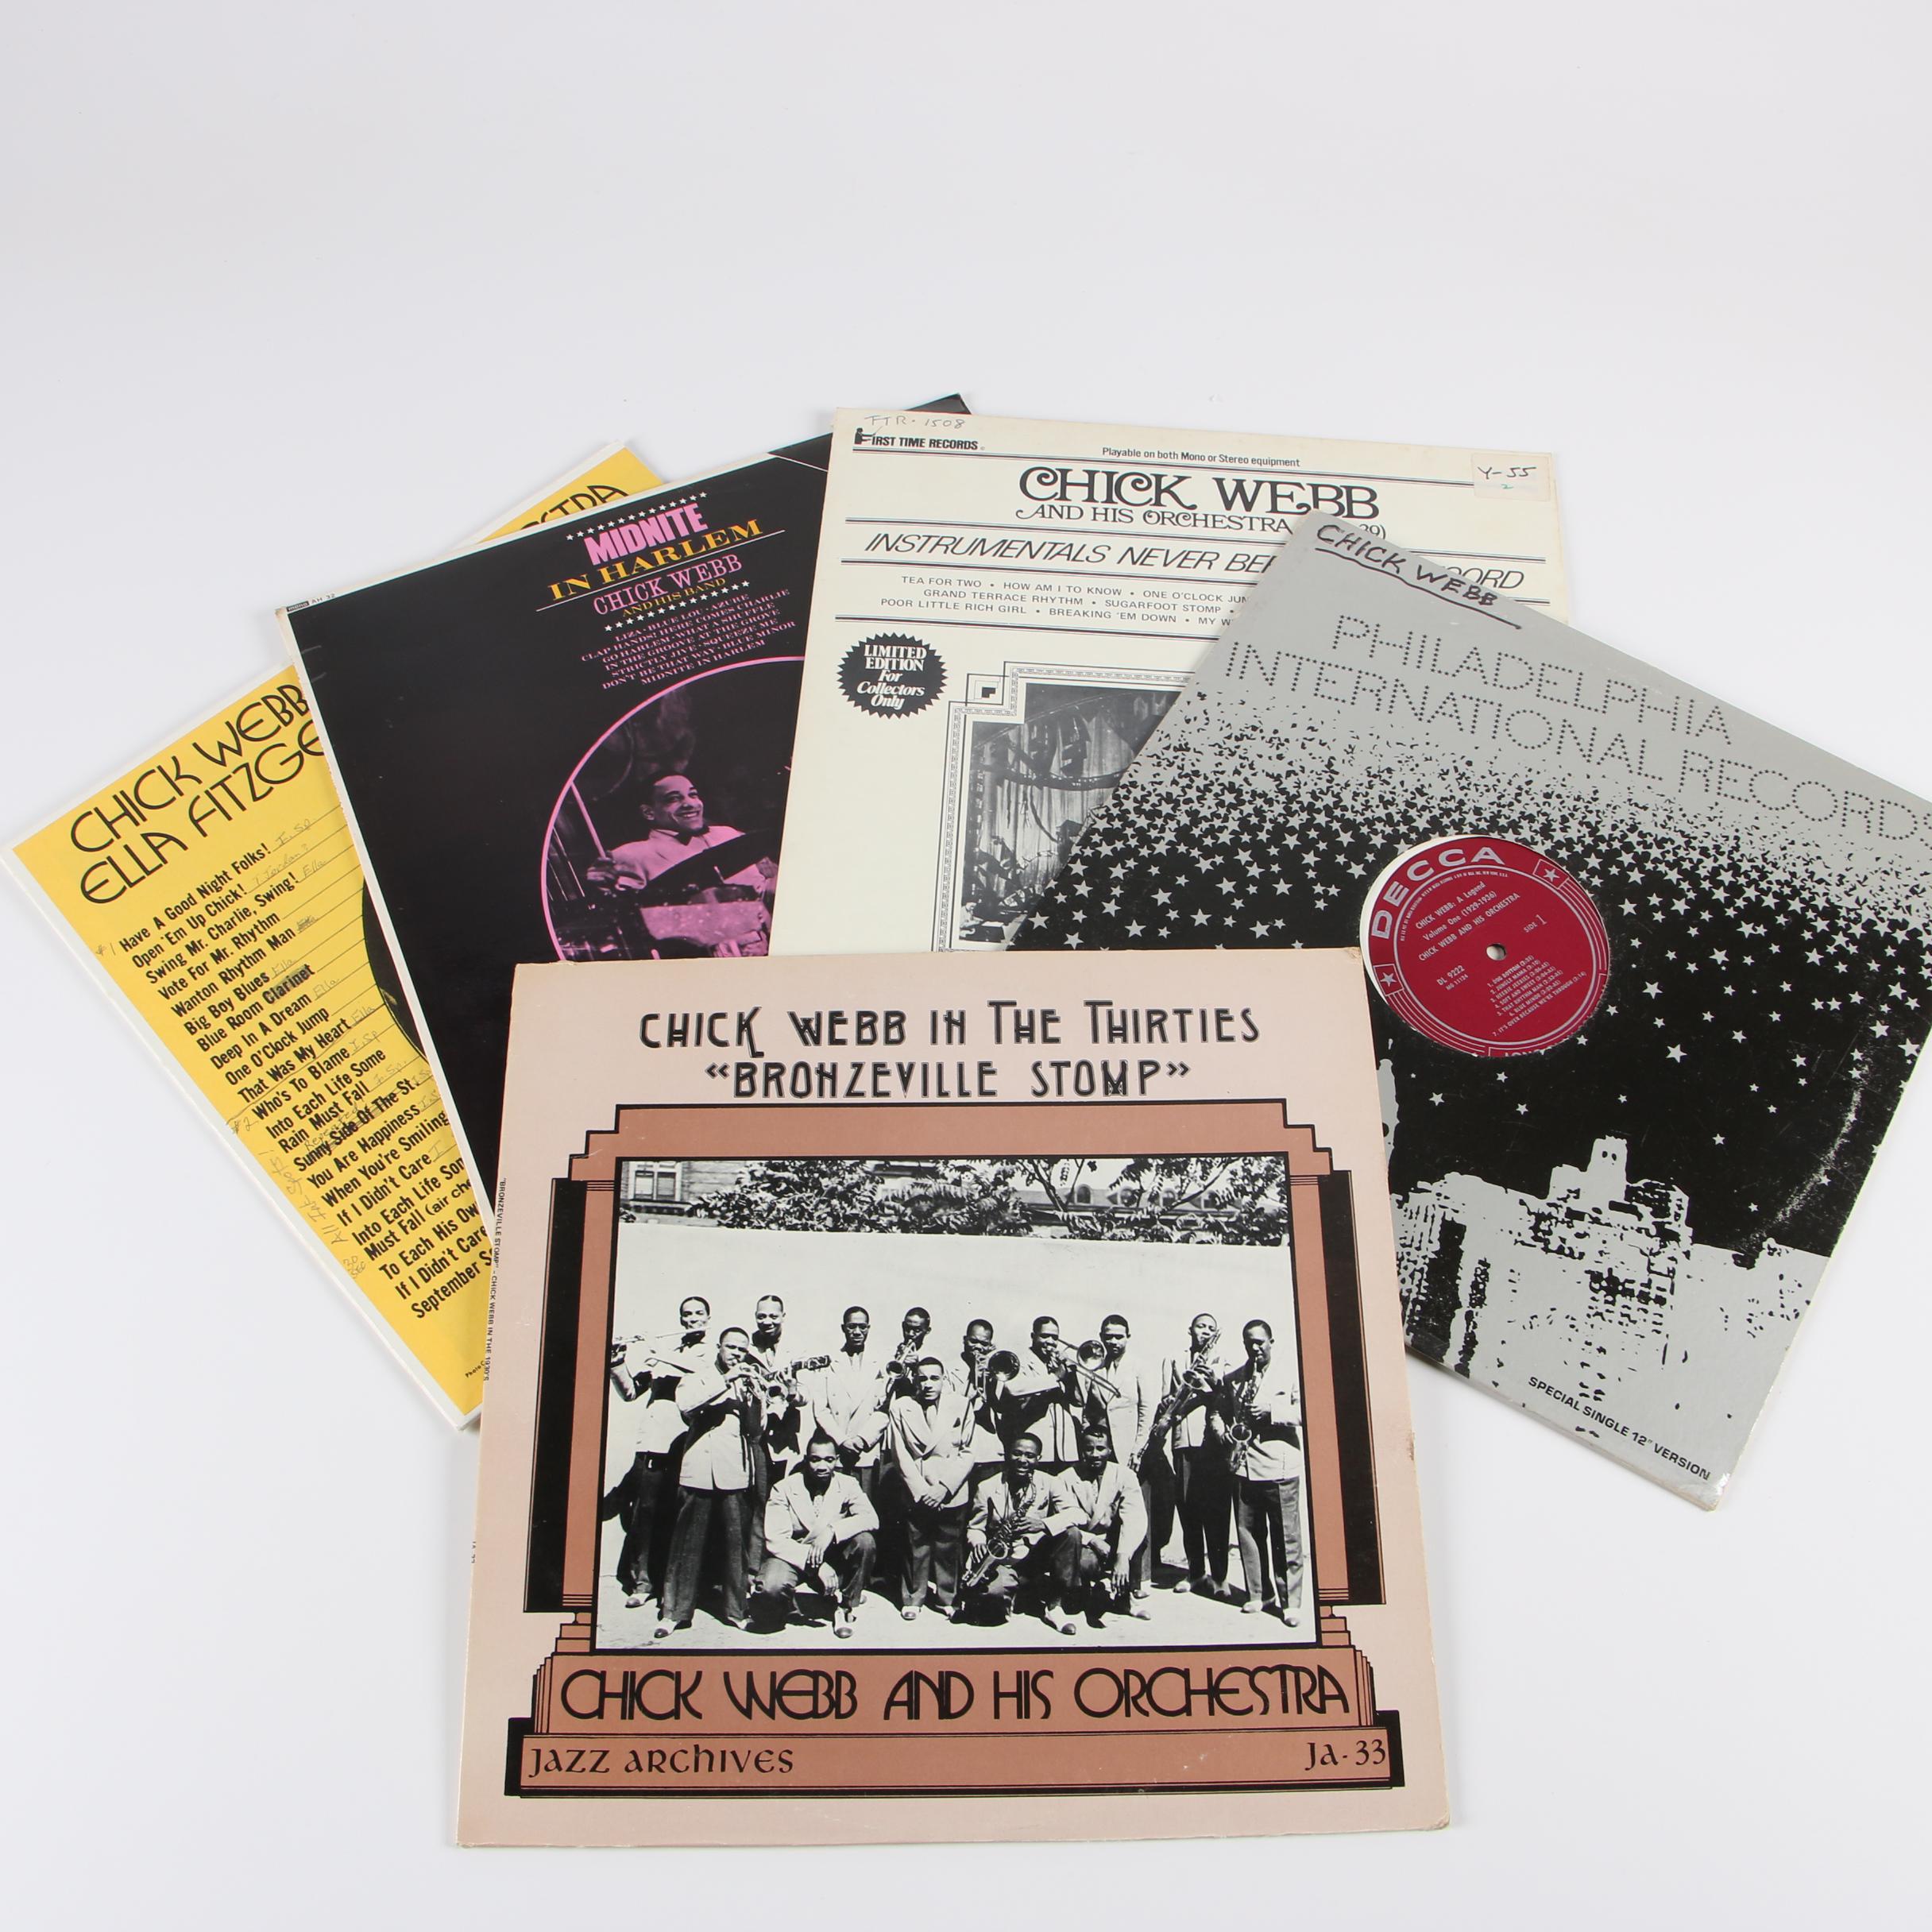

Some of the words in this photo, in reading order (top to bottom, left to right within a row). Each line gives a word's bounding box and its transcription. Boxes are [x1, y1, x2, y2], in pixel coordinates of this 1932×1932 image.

[898, 437, 925, 447] TIME
[929, 439, 978, 450] RECORDS
[1102, 446, 1142, 458] Playable
[1157, 450, 1178, 460] both
[1180, 451, 1206, 462] Mono
[1218, 454, 1249, 464] Stereo
[1250, 457, 1300, 467] equipment
[1019, 466, 1197, 510] CHICK
[1212, 477, 1379, 519] WEBB
[584, 503, 709, 566] MIDNITE
[1015, 504, 1084, 520] AND
[1091, 506, 1134, 524] HIS
[1142, 509, 1294, 535] ORCHESTRA
[549, 574, 590, 600] IN
[597, 519, 763, 583] HARLEM
[864, 533, 1111, 563] INSTRUMENTALS
[1116, 547, 1220, 570] NEVER
[1317, 524, 1405, 574] CHICK
[1416, 565, 1497, 605] WEBB
[593, 577, 668, 615] CHICK
[667, 554, 742, 589] WEBB
[623, 601, 653, 616] AND
[654, 591, 682, 605] HIS
[683, 578, 725, 596] BAND
[880, 598, 913, 607] POOR
[918, 600, 960, 610] LITTLE
[964, 603, 993, 612] RICH
[998, 605, 1026, 614] GIRL
[1049, 608, 1111, 619] BREAKING
[1141, 613, 1177, 623] DOWN
[902, 576, 925, 585] TEA
[956, 579, 982, 588] TWO
[1003, 582, 1030, 590] HOW
[1087, 586, 1122, 596] KNOW
[1142, 589, 1167, 599] ONE
[1172, 591, 1223, 602] O'CLOCK
[923, 589, 966, 598] GRAND
[972, 591, 1026, 602] TERRACE
[1032, 595, 1083, 605] RHYTHM
[1105, 599, 1178, 611] SUGARFOOT
[1182, 604, 1221, 613] STOMP
[640, 662, 695, 685] MIDNITE
[696, 658, 712, 667] IN
[712, 639, 766, 662] HARLEM
[864, 644, 927, 659] LIMITED
[865, 656, 924, 671] EDITION
[878, 670, 903, 682] For
[856, 681, 925, 697] Collectors
[871, 694, 905, 710] Only
[1332, 614, 1733, 745] PHILADELPHIA
[1224, 642, 1664, 782] INTERNATIONAL
[71, 755, 203, 852] CHICK
[192, 684, 309, 767] WEBB
[79, 832, 188, 904] ELLA
[1371, 847, 1505, 939] DECCA
[118, 928, 150, 952] Have
[153, 916, 166, 930] A
[164, 892, 198, 920] Good
[195, 870, 233, 899] Night
[230, 843, 271, 875] Folks!
[1415, 914, 1435, 929] CHICK
[1434, 902, 1456, 916] WEBB:
[1463, 881, 1486, 898] Legend
[1422, 924, 1447, 941] Volume
[1447, 915, 1461, 925] One
[1461, 891, 1497, 917] (1929-1936)
[1523, 922, 1538, 933] SIDE
[1536, 915, 1547, 925] 1
[132, 943, 164, 968] Open
[160, 927, 187, 945] 'Em
[185, 914, 207, 929] Up
[204, 883, 247, 917] Chick!
[145, 952, 187, 983] Swing
[184, 939, 208, 956] Mr.
[207, 907, 257, 941] Charlie,
[253, 872, 299, 907] Swing!
[1418, 945, 1439, 960] CHICK
[1437, 933, 1457, 948] WEBB
[1458, 923, 1472, 936] AND
[1472, 914, 1485, 925] HIS
[1485, 893, 1520, 917] ORCHESTRA
[157, 978, 188, 1000] Vote
[187, 961, 210, 980] For
[209, 947, 234, 964] Mr.
[230, 913, 280, 950] Rhythm
[170, 982, 219, 1018] Wanton
[218, 948, 267, 985] Rhythm
[265, 928, 296, 951] Man
[1436, 976, 1447, 985] DL
[1447, 964, 1465, 978] 9222
[184, 1015, 211, 1036] Big
[207, 997, 234, 1018] Boy
[232, 972, 270, 1001] Blues
[196, 1028, 227, 1052] Blue
[226, 1001, 264, 1030] Room
[261, 964, 315, 1004] Clarinet
[639, 1007, 764, 1058] CHICK
[787, 1010, 906, 1046] WEBB
[930, 1010, 966, 1045] IN
[1528, 1376, 1579, 1411] SPECIAL
[1582, 1405, 1629, 1436] SINGLE
[1654, 1443, 1710, 1480] VERSION
[561, 1669, 703, 1720] CHICK
[723, 1669, 857, 1720] WEBB
[883, 1670, 975, 1720] AND
[993, 1669, 1054, 1719] HIS
[1074, 1664, 1350, 1718] ORCHESTRA
